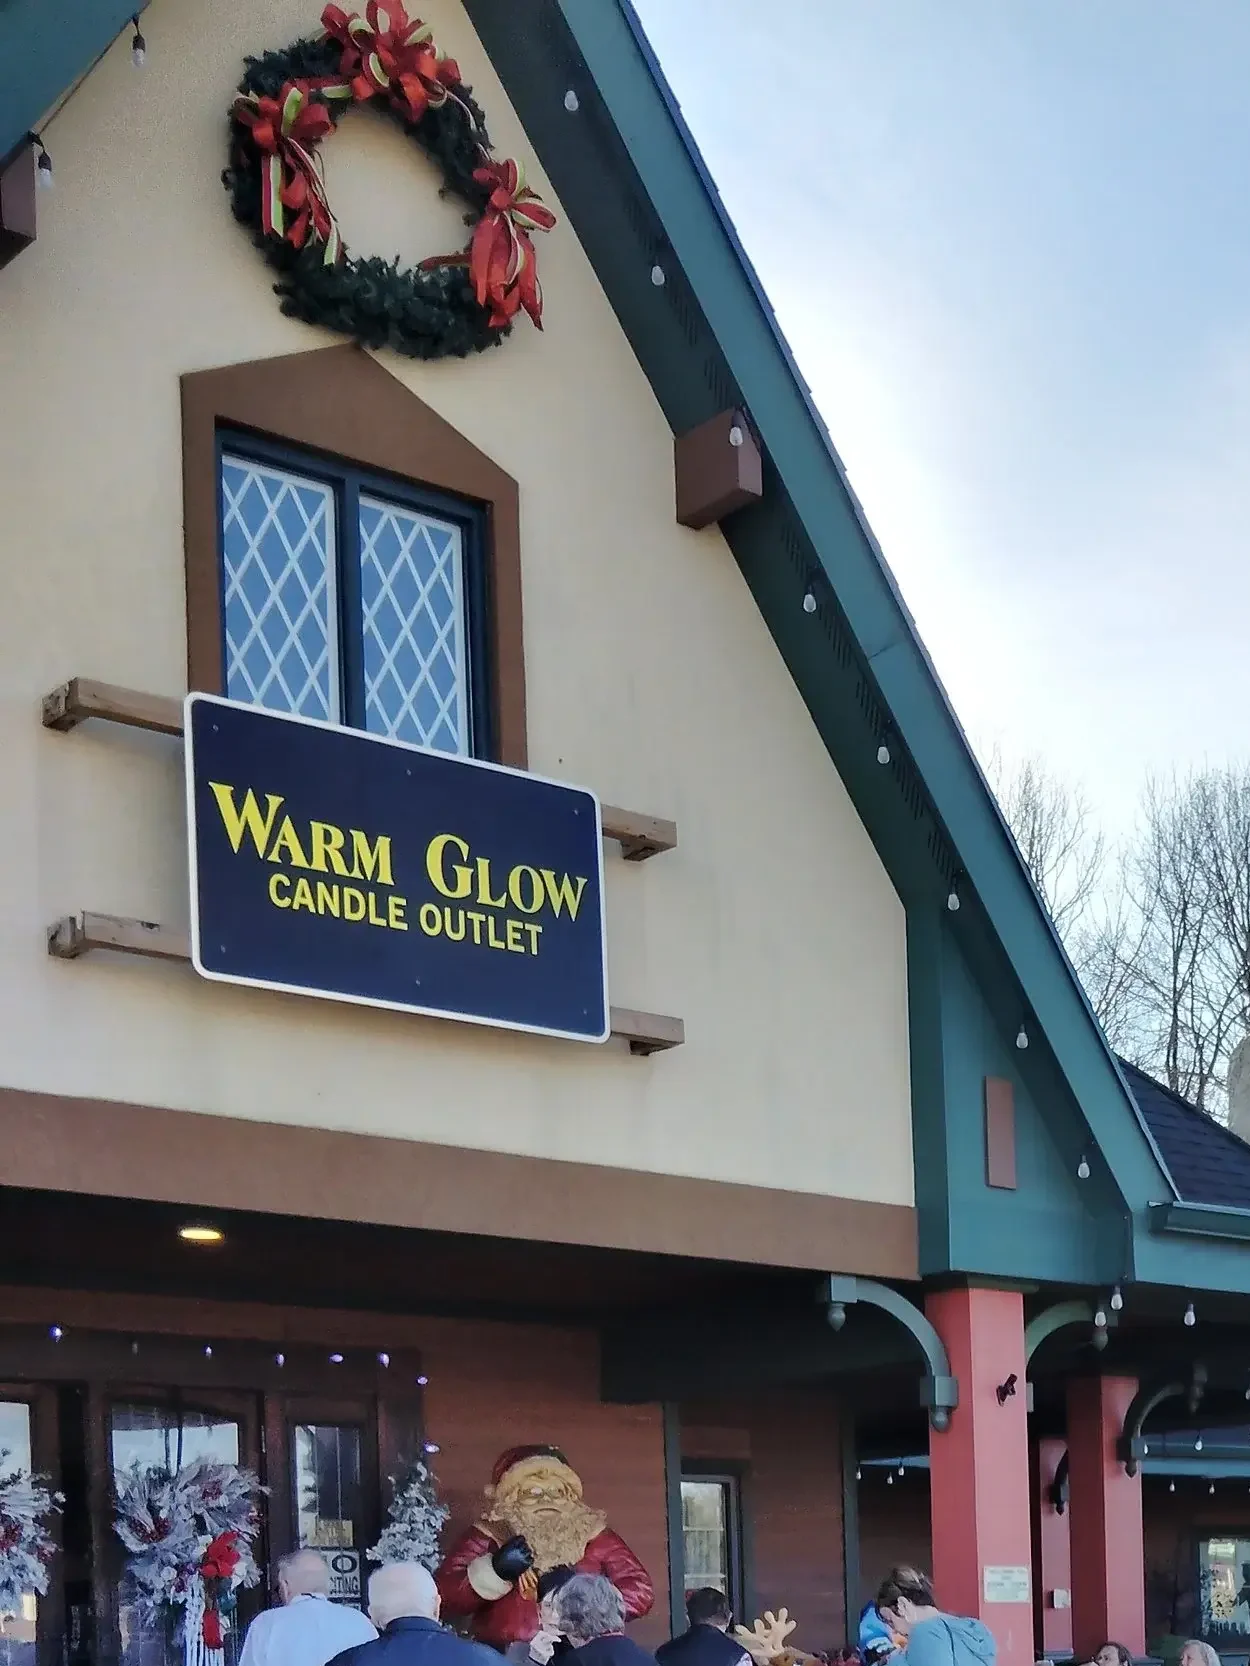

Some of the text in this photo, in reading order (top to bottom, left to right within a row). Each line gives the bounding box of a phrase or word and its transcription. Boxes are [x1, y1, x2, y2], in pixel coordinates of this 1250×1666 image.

[208, 781, 588, 922] WARM GLOW
[268, 872, 543, 956] CANDLE OUTLET
